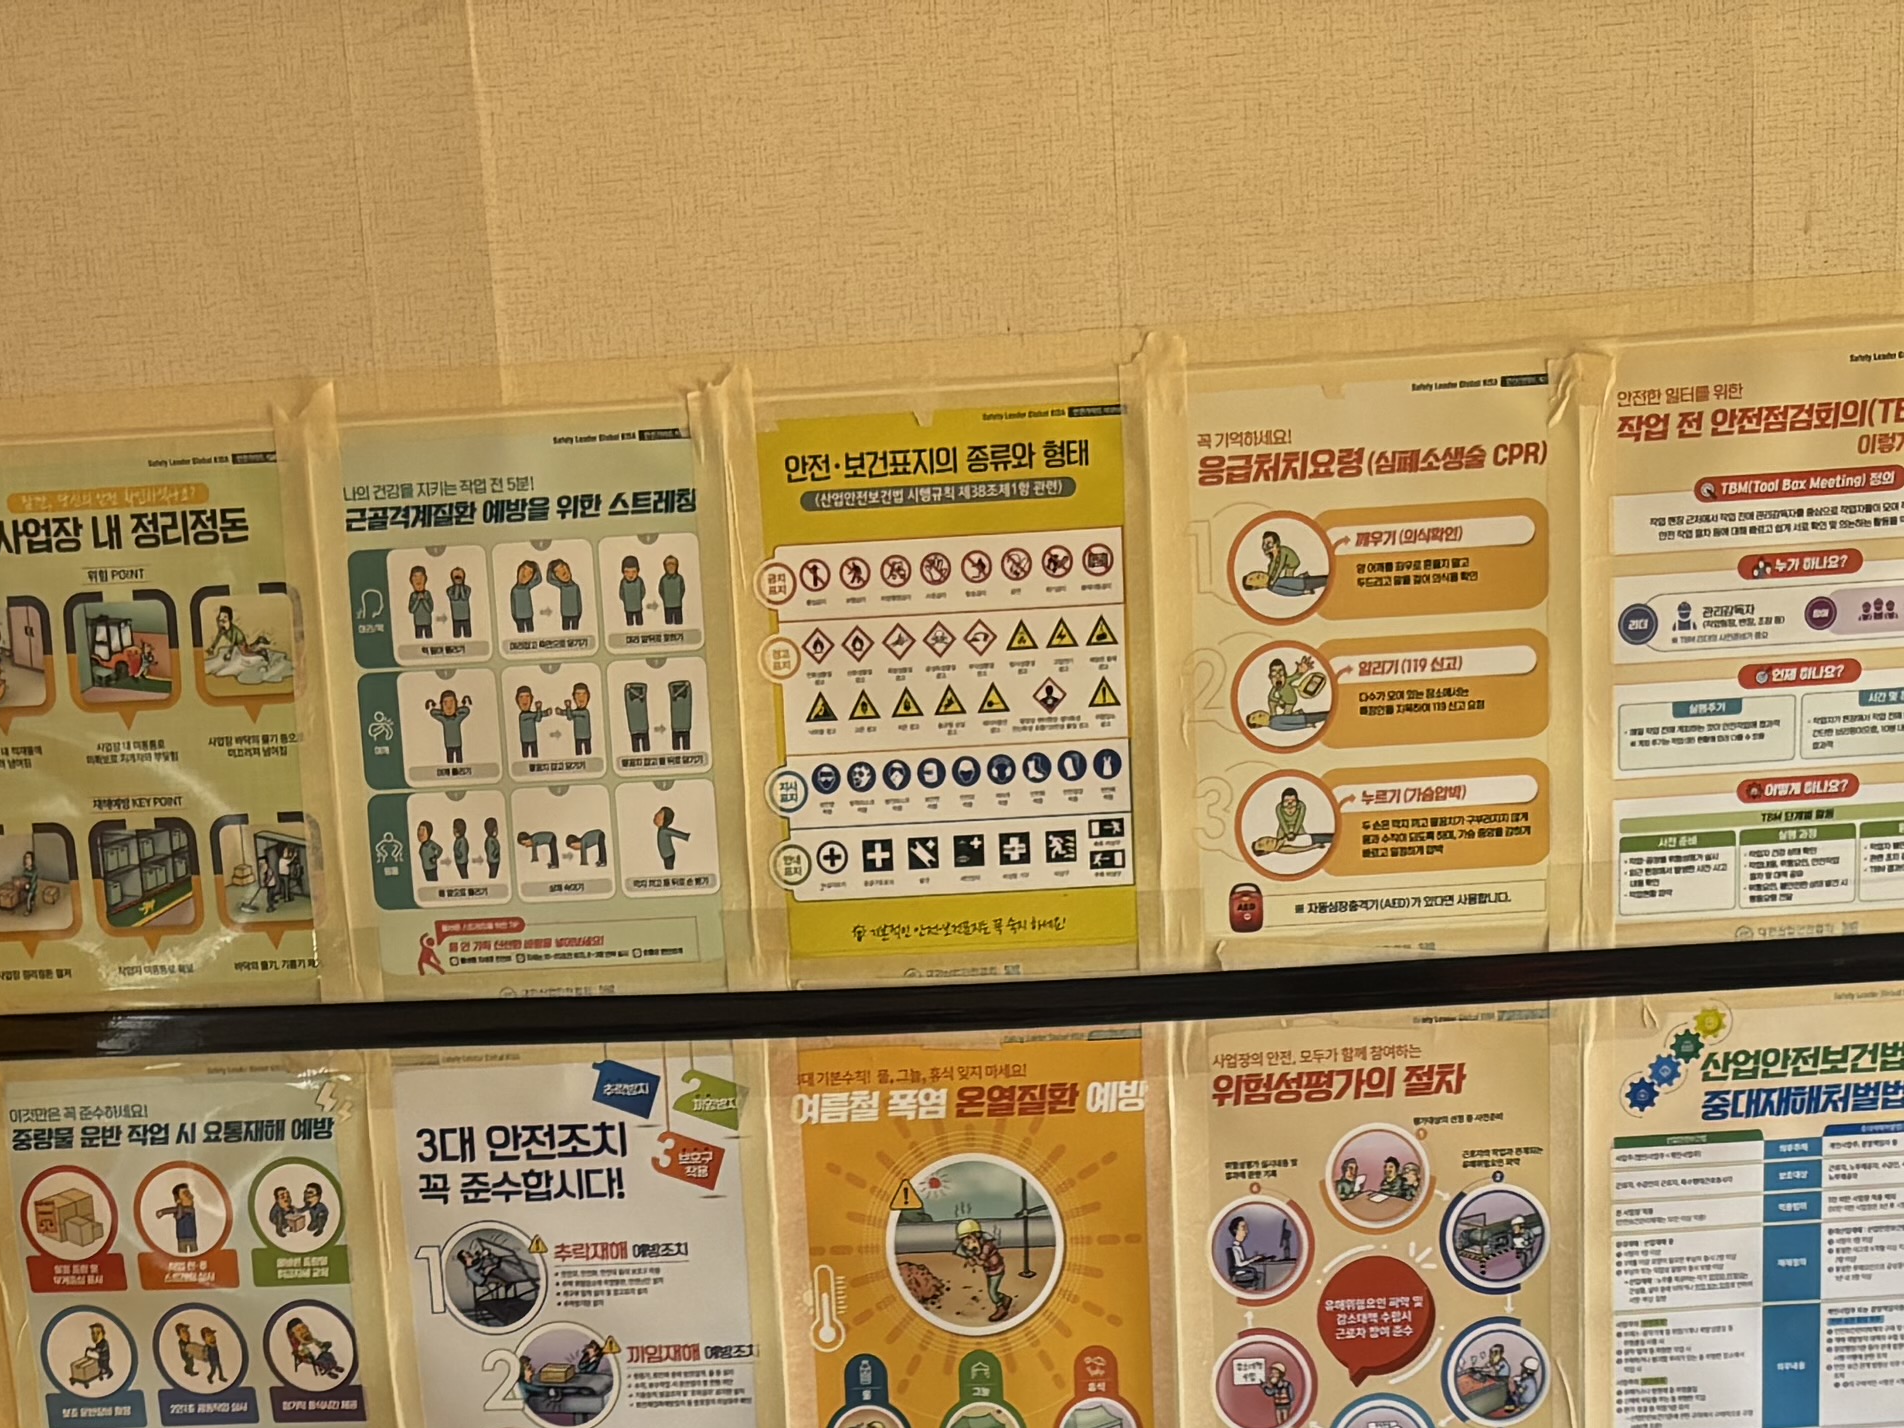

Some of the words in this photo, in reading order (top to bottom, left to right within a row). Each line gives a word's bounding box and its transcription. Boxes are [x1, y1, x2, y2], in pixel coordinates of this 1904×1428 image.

[1617, 388, 1662, 408] 안전한
[1666, 385, 1710, 404] 일터를
[1713, 383, 1743, 401] 위한
[1197, 434, 1211, 449] 꼭
[1215, 429, 1292, 448] 기억하세요!
[1617, 412, 1670, 443] 작업
[1677, 410, 1703, 439] 전
[784, 447, 957, 483] 안전·보건표지의
[967, 441, 1035, 471] 종류와
[1043, 439, 1089, 468] 형태
[1198, 447, 1365, 486] 응급처치요령
[1368, 445, 1486, 476] (심폐소생술
[1494, 441, 1548, 467] CPR)
[343, 485, 369, 501] 나의
[373, 483, 413, 499] 건강을
[417, 481, 457, 498] 지키는
[460, 478, 487, 495] 작업
[491, 478, 504, 493] 전
[507, 476, 534, 492] 5분!
[1720, 480, 1779, 497] TBM(Tool
[1782, 478, 1806, 492] Box
[1869, 470, 1895, 486] 정의
[345, 501, 476, 532] 근골격계질환
[482, 497, 550, 525] 예방을
[556, 493, 602, 519] 위한
[608, 488, 697, 516] 스트레칭
[815, 487, 904, 508] (산업안전보건법
[92, 515, 123, 551] 내
[131, 507, 249, 547] 정리정돈
[1355, 530, 1397, 547] 깨우기
[1399, 526, 1463, 545] (의식확인)
[111, 568, 145, 581] POINT
[1775, 558, 1799, 572] 누가
[1803, 554, 1848, 572] 하나요?
[1358, 659, 1398, 676] 알리기
[1431, 656, 1462, 673] 신고)
[1361, 788, 1401, 806] 누르기
[1403, 784, 1466, 804] (가슴압박)
[1213, 1052, 1263, 1068] 사업장의
[1267, 1051, 1295, 1066] 안전,
[1300, 1048, 1338, 1064] 모두가
[1341, 1047, 1367, 1062] 함께
[1370, 1045, 1422, 1060] 참여하는
[797, 1072, 814, 1087] 대
[985, 1063, 1027, 1079] 마세요!
[1212, 1066, 1396, 1107] 위험성평가의
[1403, 1062, 1466, 1099] 절차
[9, 1107, 61, 1123] 이것만은
[63, 1107, 76, 1121] 꼭
[79, 1104, 148, 1120] 준수하세요!
[792, 1090, 880, 1125] 여름철
[887, 1087, 948, 1120] 폭염
[955, 1082, 1080, 1119] 온열질환
[1086, 1080, 1148, 1113] 예방
[12, 1127, 75, 1151] 중량물
[81, 1125, 121, 1148] 운반
[128, 1123, 170, 1145] 작업
[176, 1122, 196, 1145] 시
[203, 1119, 285, 1143] 요통재해
[291, 1117, 336, 1140] 예방
[416, 1125, 476, 1163] 3대
[486, 1121, 628, 1162] 안전조치
[419, 1175, 450, 1205] 꼭
[460, 1167, 625, 1203] 준수합시다!
[554, 1241, 628, 1260] 추락재해
[627, 1344, 701, 1364] 끼임재해
